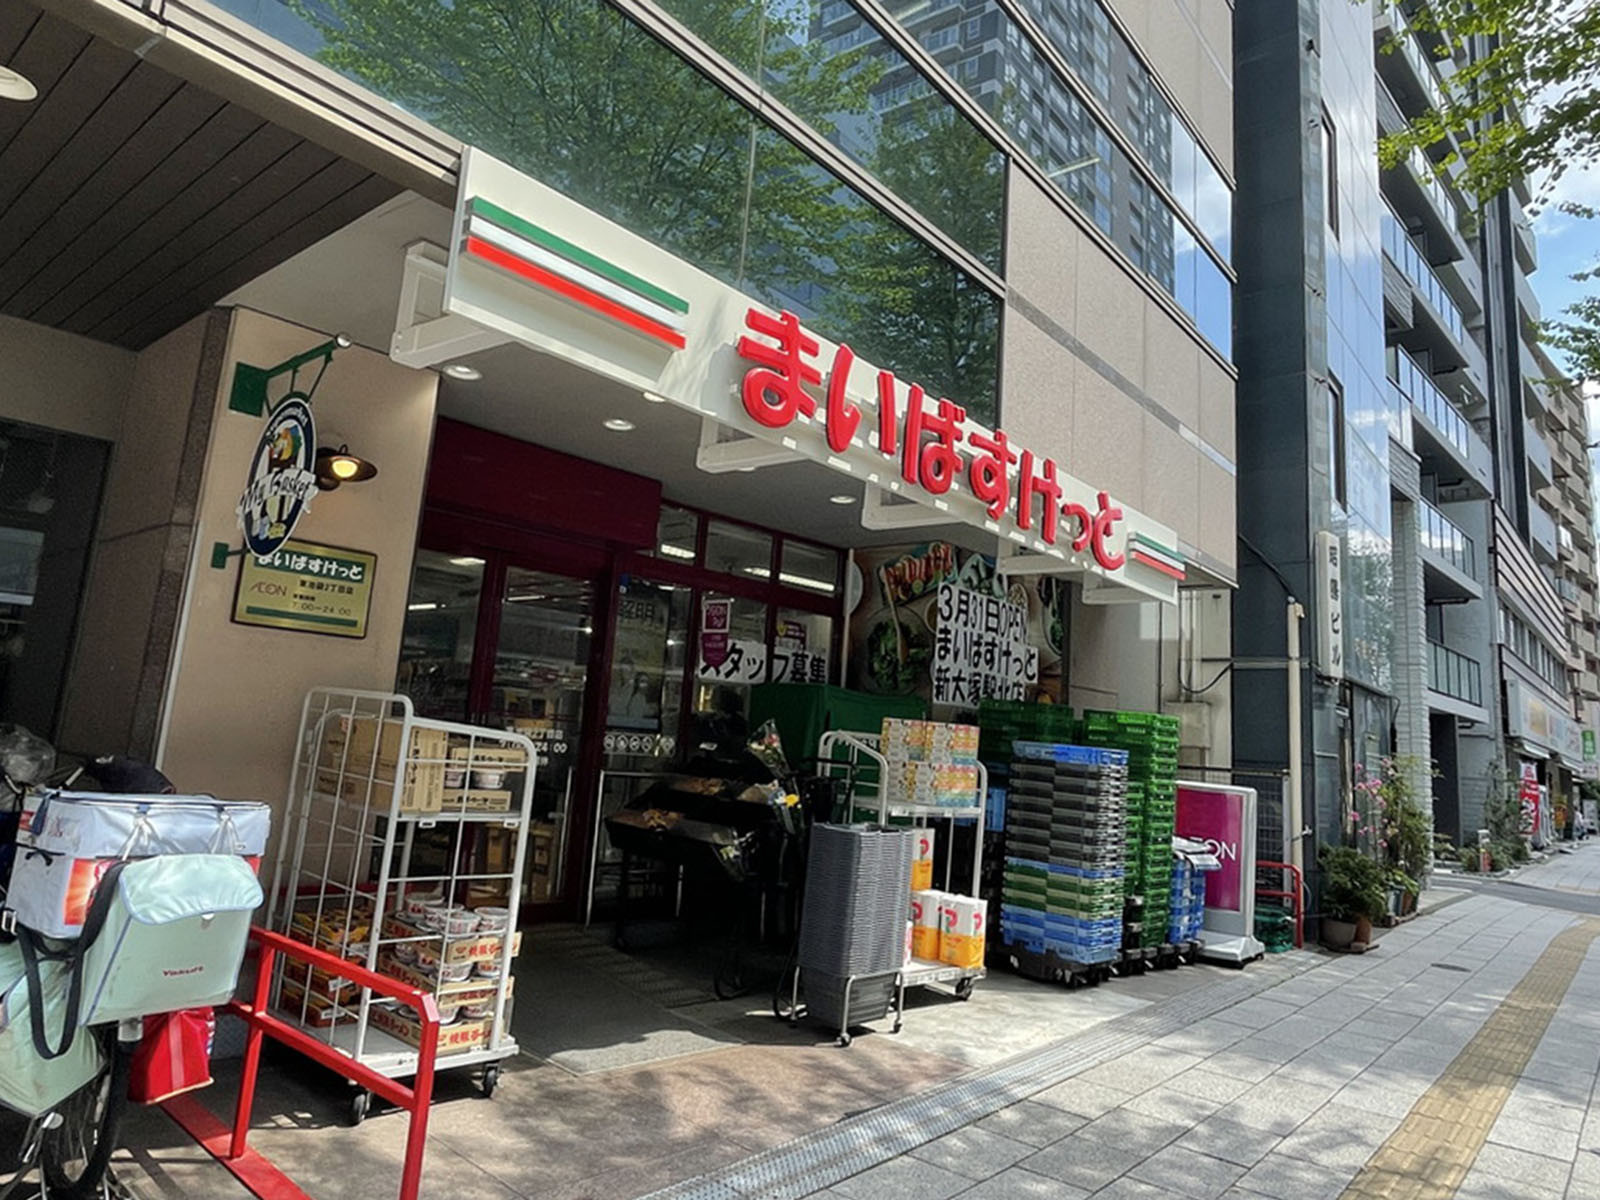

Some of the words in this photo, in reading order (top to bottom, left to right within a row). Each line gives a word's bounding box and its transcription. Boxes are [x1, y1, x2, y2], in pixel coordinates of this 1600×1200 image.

[738, 309, 1126, 571] まいばすけっと
[937, 625, 1036, 681] まいばすけっと
